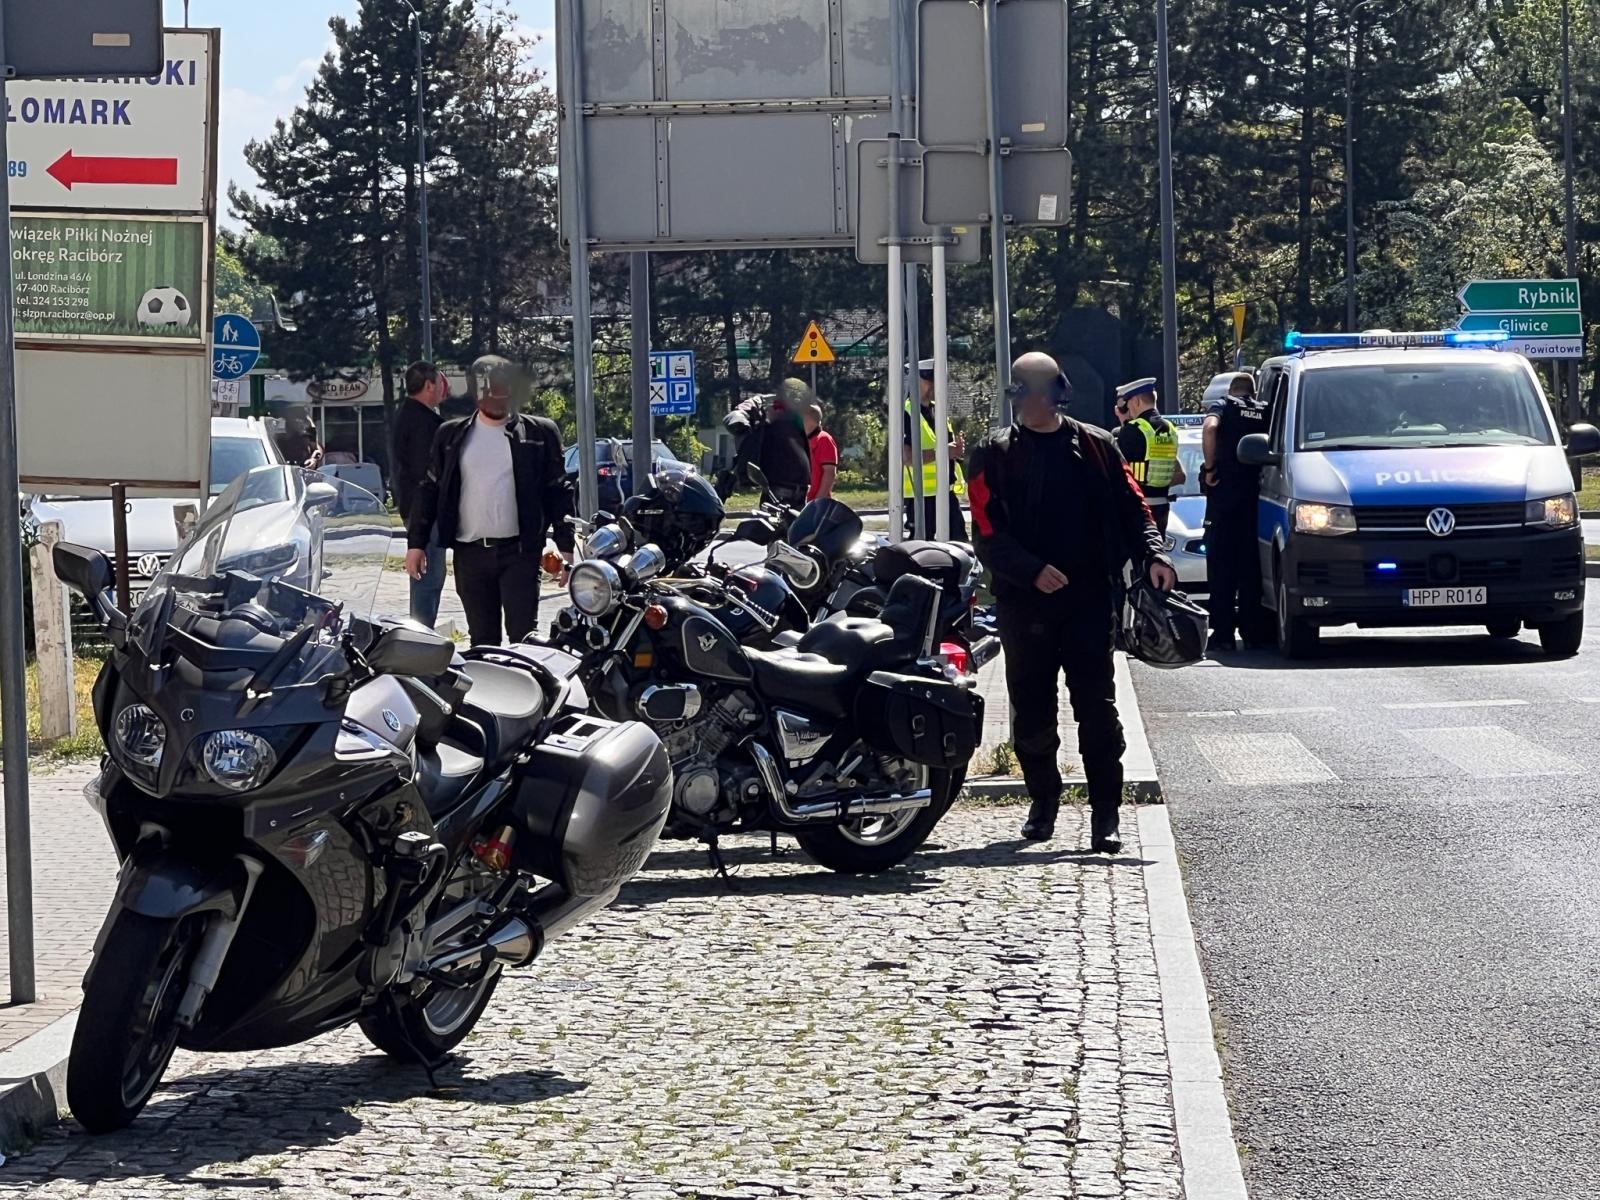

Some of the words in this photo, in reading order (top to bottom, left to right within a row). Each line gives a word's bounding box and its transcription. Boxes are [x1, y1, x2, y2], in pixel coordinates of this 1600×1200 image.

[65, 227, 98, 242] Piłki
[102, 229, 153, 246] Nożnej
[13, 246, 55, 263] okręg
[58, 248, 122, 263] Racibórz
[15, 271, 26, 280] ul.
[28, 271, 68, 281] Londzina
[70, 273, 92, 282] 46/6
[16, 284, 49, 293] 47-400
[16, 296, 31, 305] tel.
[33, 296, 50, 305] 324
[53, 297, 70, 306] 153
[72, 298, 89, 307] 298
[1518, 287, 1575, 308] Rybnik
[22, 309, 116, 321] slzpn.raciborz@op.pl
[1499, 319, 1549, 332] Gliwice
[1524, 343, 1581, 355] Powiatowe
[1240, 410, 1262, 420] POLICJA
[1375, 470, 1464, 487] POLIC
[1412, 590, 1440, 605] HPP
[1446, 588, 1483, 604] R016
